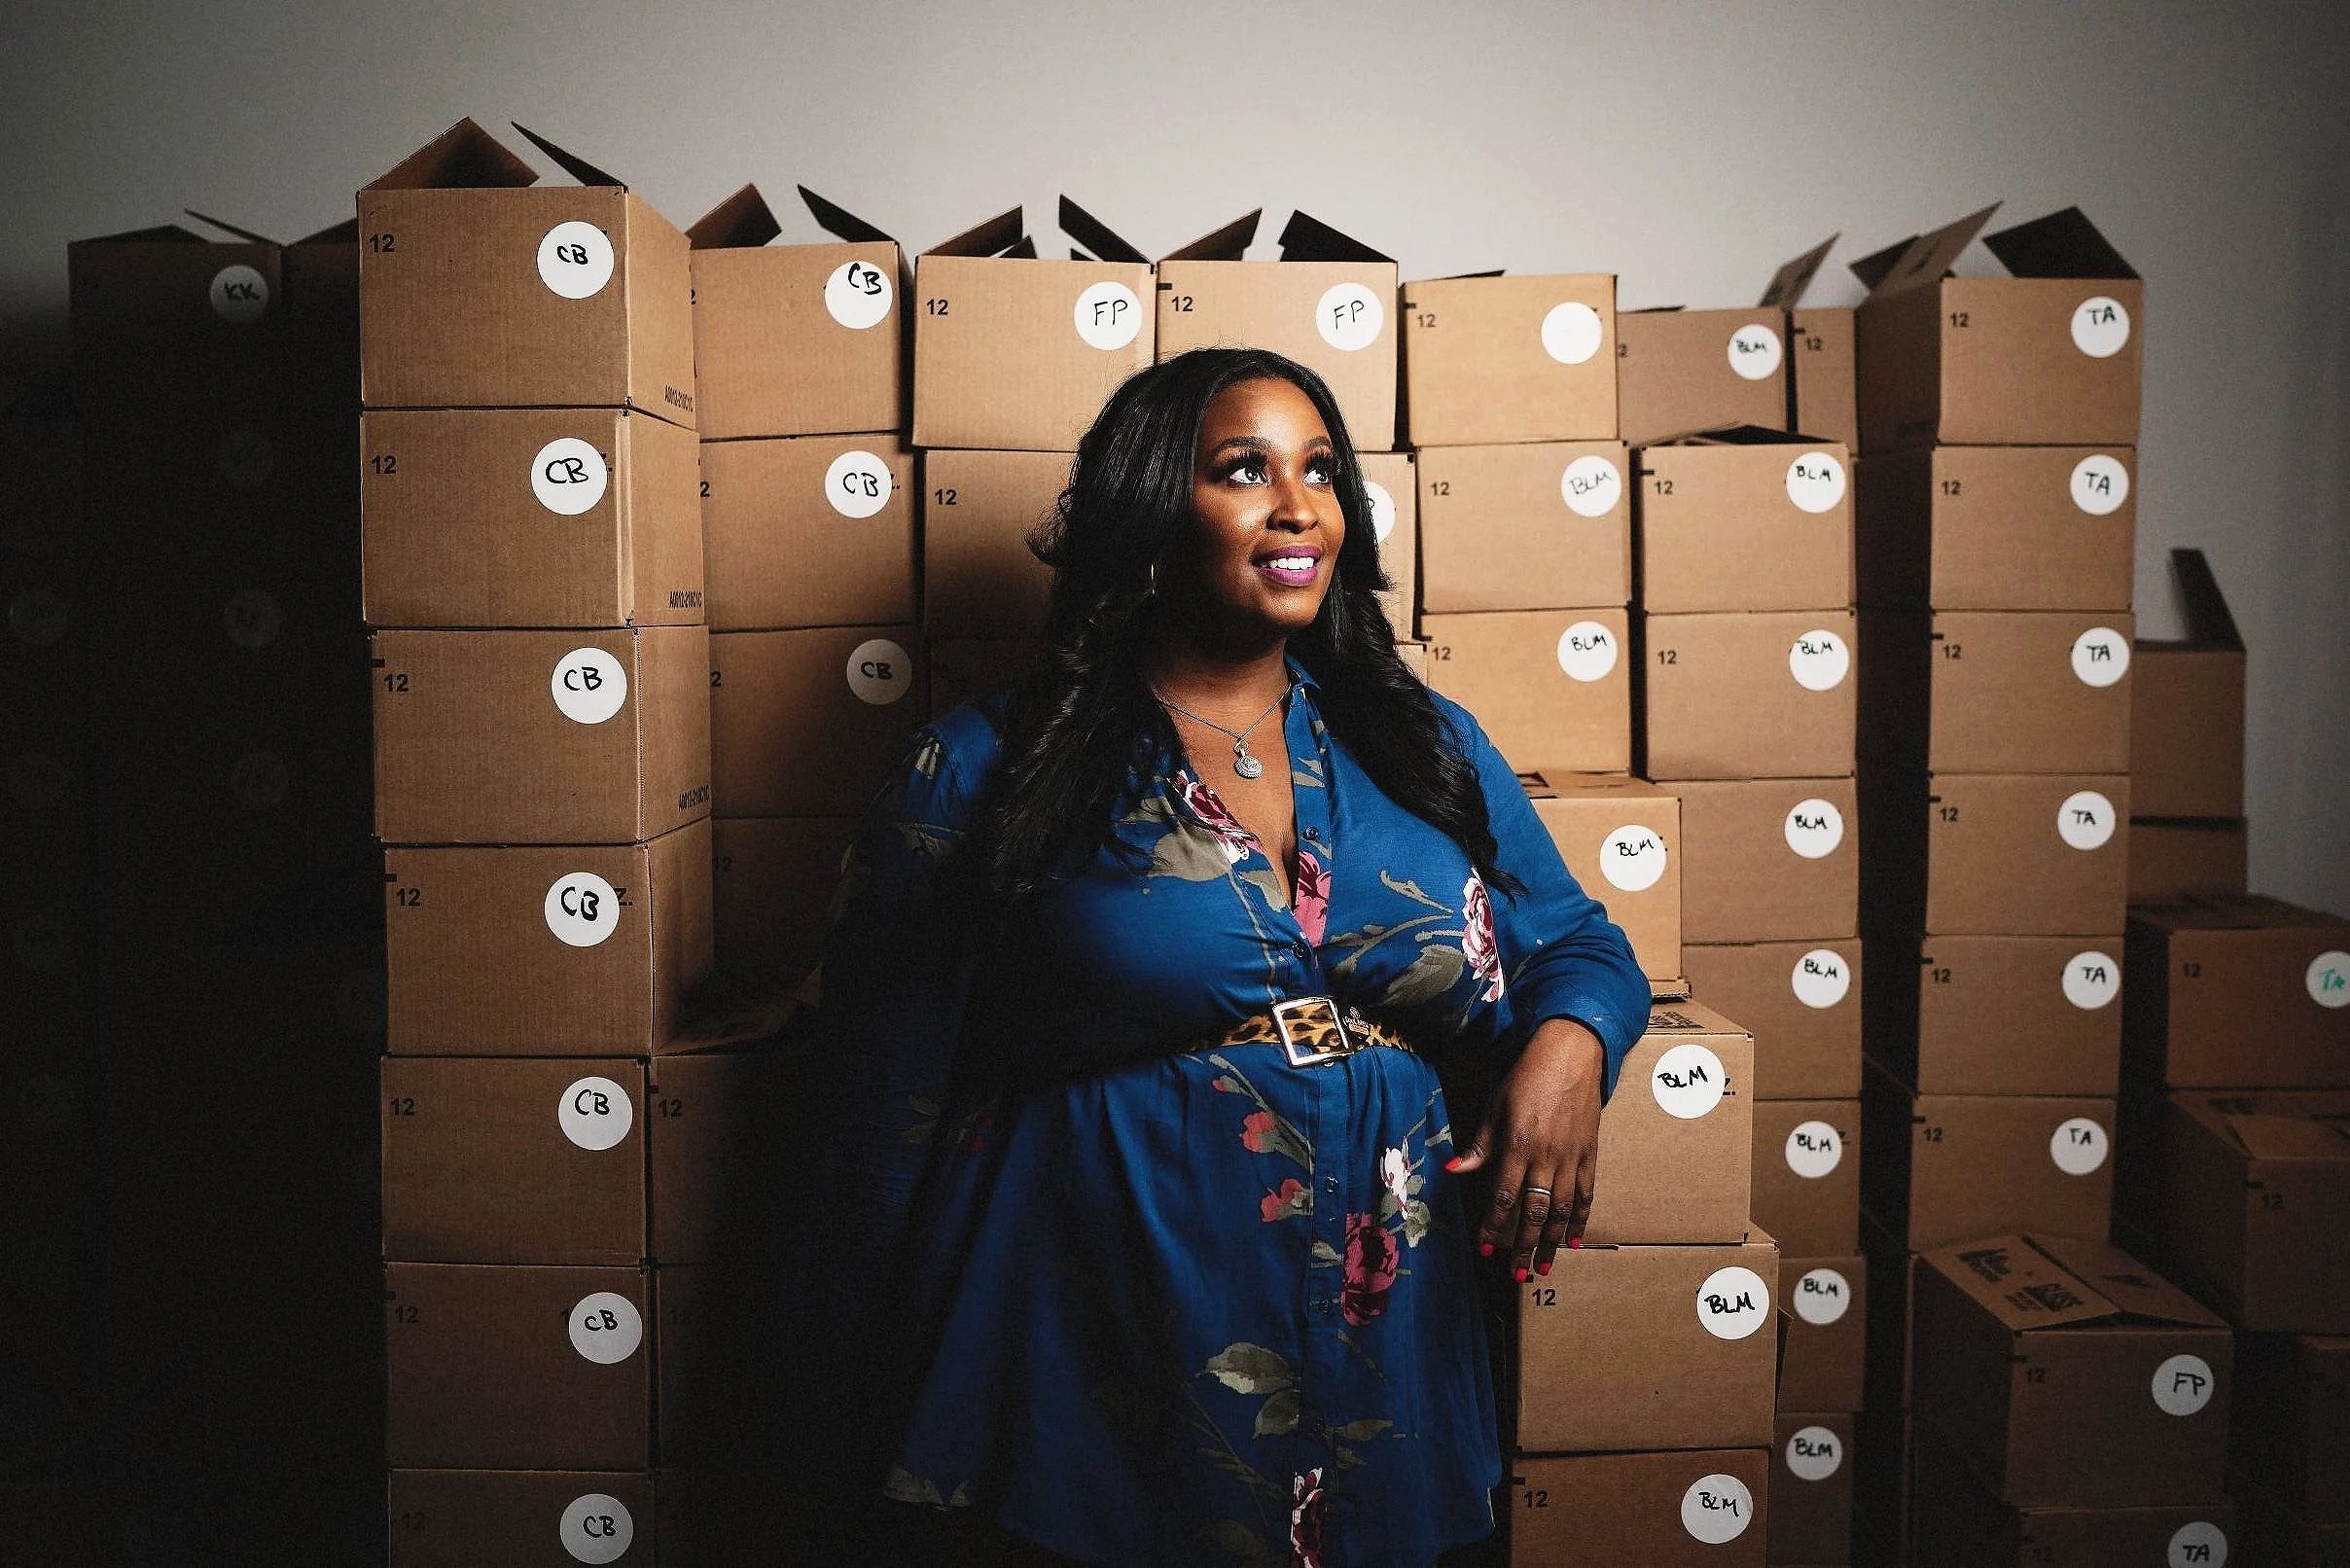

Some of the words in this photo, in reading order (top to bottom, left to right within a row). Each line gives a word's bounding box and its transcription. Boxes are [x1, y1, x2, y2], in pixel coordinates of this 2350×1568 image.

[369, 233, 396, 254] 12
[556, 243, 589, 266] CB
[847, 263, 882, 296] CB
[926, 299, 949, 316] 12
[1093, 299, 1128, 327] FP
[1171, 296, 1193, 312] 12
[1333, 300, 1365, 331] FP
[1417, 312, 1436, 329] 12
[1949, 312, 1970, 329] 12
[2087, 304, 2117, 326] TA
[1804, 337, 1824, 352] 12
[371, 454, 397, 475] 12
[545, 457, 589, 484] CB
[1796, 465, 1832, 481] BLM
[699, 480, 711, 498] 2
[842, 472, 879, 498] CB
[1430, 481, 1450, 496] 12
[1569, 471, 1612, 496] BLM
[1655, 480, 1673, 495] 12
[1941, 480, 1962, 496] 12
[2084, 471, 2111, 496] TA
[934, 488, 957, 506] 12
[1571, 634, 1607, 652] BLM
[1798, 639, 1834, 656] BLM
[1942, 644, 1962, 660] 12
[2086, 644, 2111, 662] TA
[1432, 646, 1451, 661] 12
[1657, 649, 1677, 665] 12
[563, 666, 603, 692] CB
[709, 671, 723, 688] 2
[860, 660, 894, 681] CB
[383, 673, 409, 694] 12
[1794, 814, 1828, 830] BLM
[1939, 806, 1959, 823] 12
[2072, 809, 2096, 826] TA
[1615, 838, 1655, 857] BLM
[395, 887, 421, 907] 12
[560, 886, 600, 922] CB
[1803, 958, 1837, 979] BLM
[1931, 968, 1952, 984] 12
[2083, 966, 2107, 984] TA
[1656, 1065, 1708, 1088] BLM
[389, 1096, 415, 1118] 12
[574, 1088, 611, 1116] CB
[658, 1097, 684, 1120] 12
[1796, 1133, 1832, 1152] BLM
[1922, 1126, 1943, 1143] 12
[2070, 1127, 2092, 1146] TA
[1531, 1288, 1556, 1307] 12
[1803, 1278, 1839, 1298] BLM
[1703, 1291, 1756, 1315] BLM
[394, 1304, 421, 1324] 12
[584, 1308, 619, 1332] CB
[2026, 1369, 2044, 1385] 12
[2172, 1372, 2207, 1397] FP
[1796, 1438, 1834, 1458] BLM
[1523, 1490, 1549, 1510] 12
[1697, 1491, 1740, 1517] BLM
[583, 1515, 617, 1539] CB
[2182, 1543, 2211, 1563] TA
